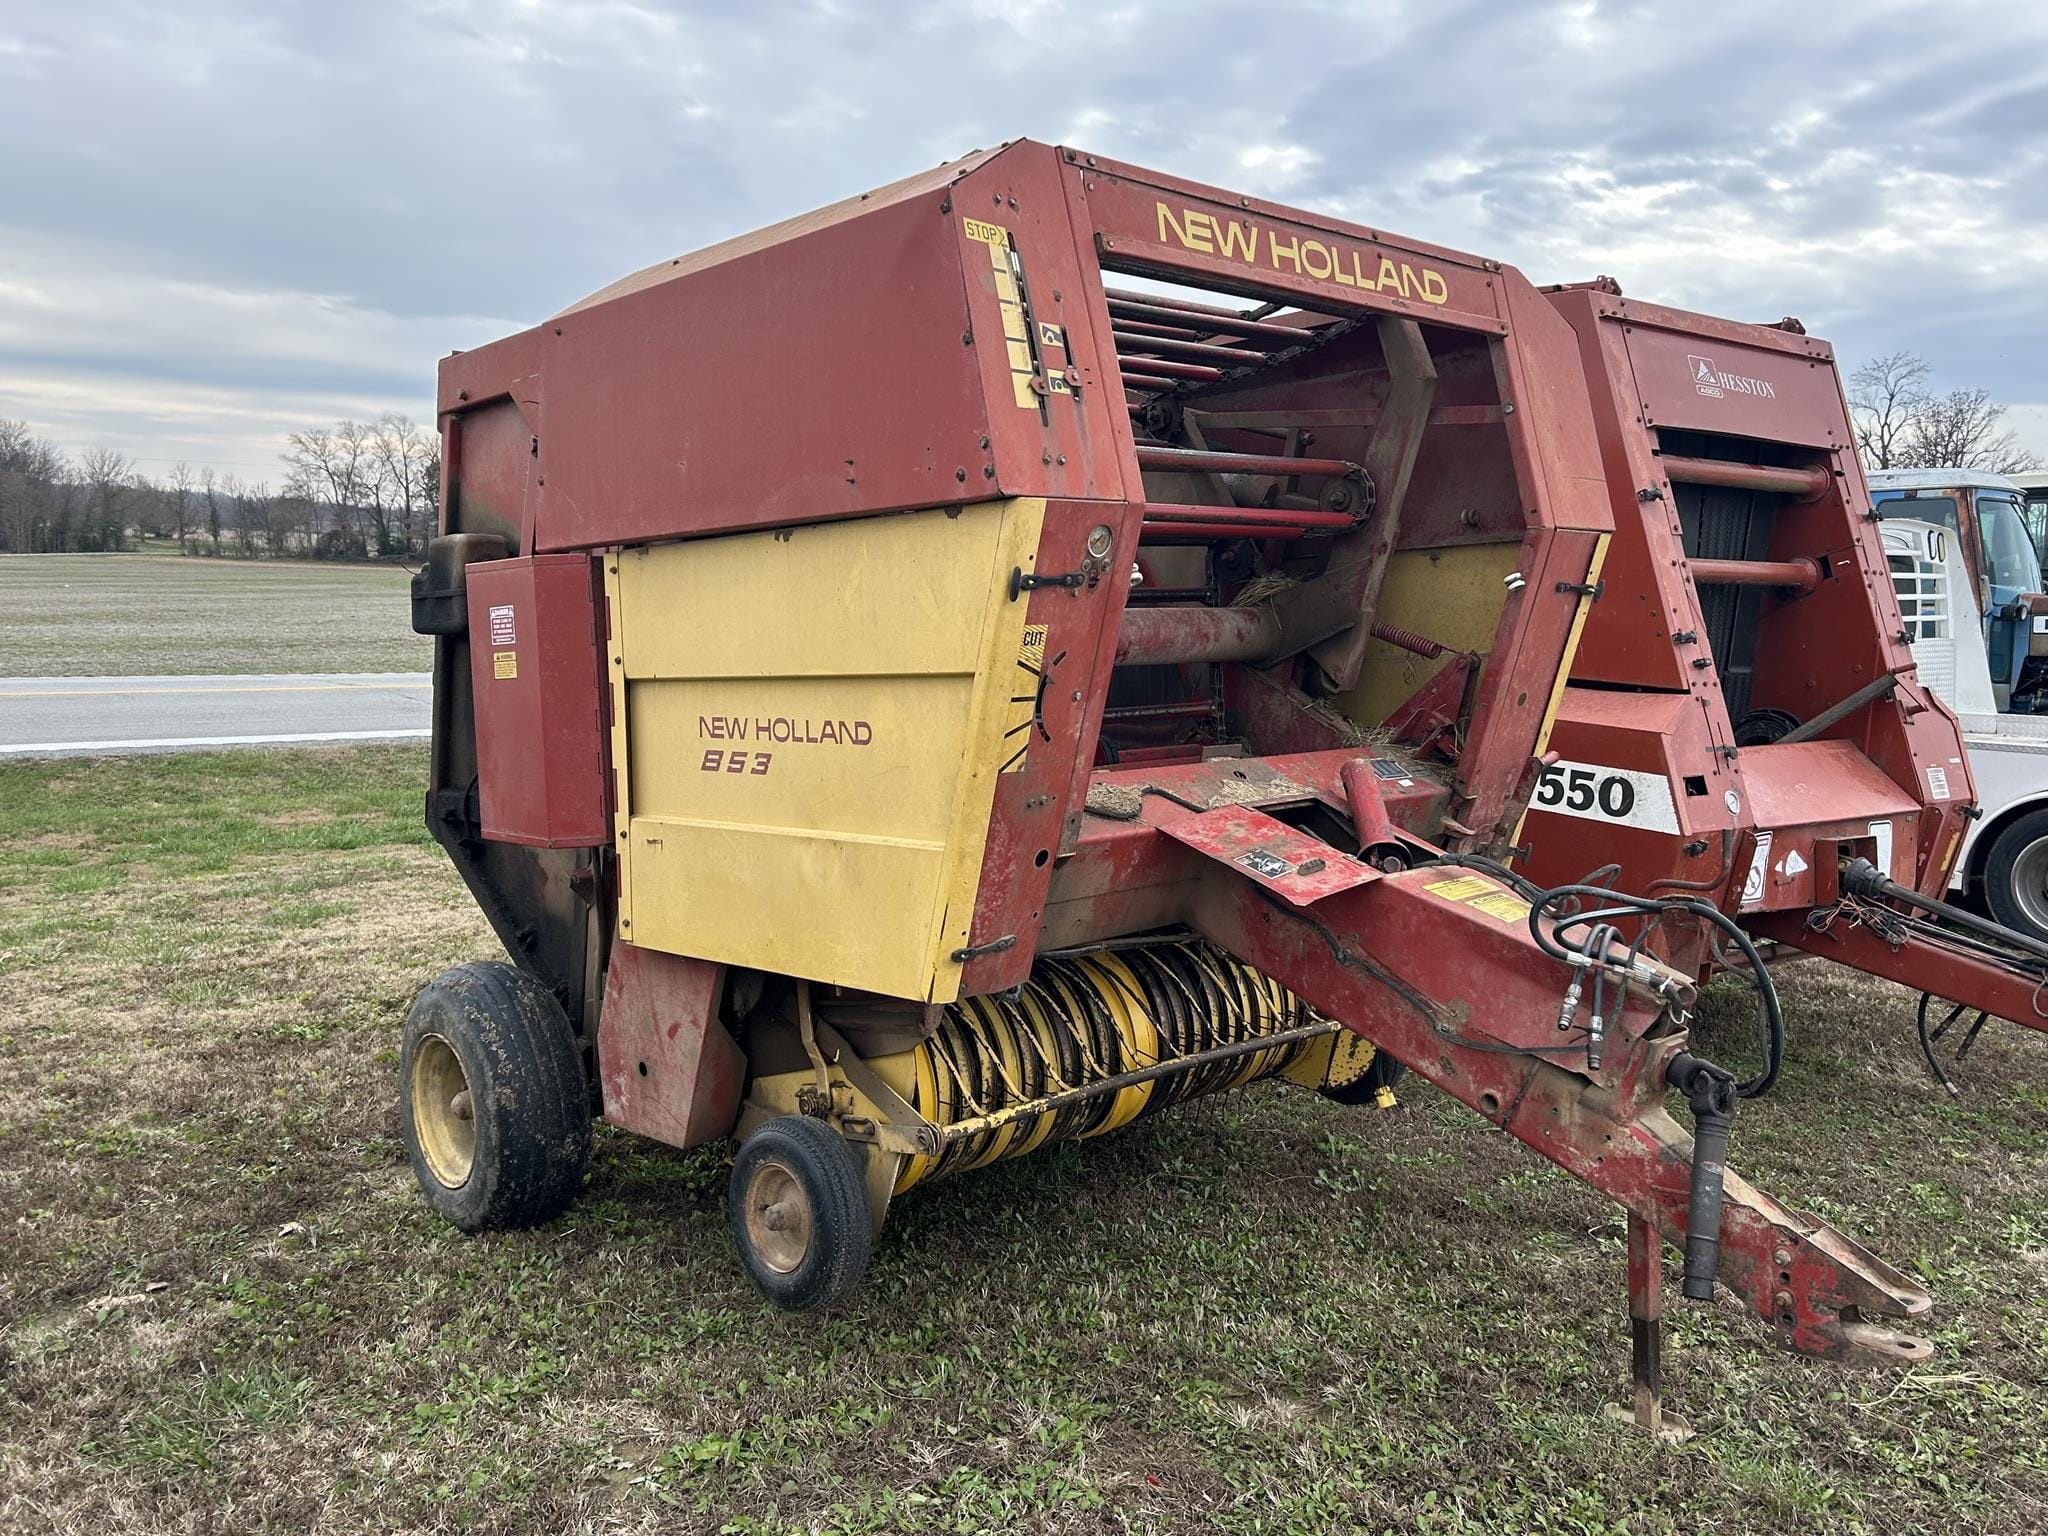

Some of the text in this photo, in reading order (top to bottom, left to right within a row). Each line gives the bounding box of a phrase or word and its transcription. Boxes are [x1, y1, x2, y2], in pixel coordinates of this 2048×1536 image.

[966, 222, 997, 241] STOP
[1156, 201, 1448, 305] NEW HOLLAND
[1718, 371, 1775, 399] HESSTON
[1023, 631, 1045, 646] CUT
[699, 716, 872, 745] NEW HOLLAND
[701, 750, 772, 775] 853
[1537, 766, 1635, 818] 550
